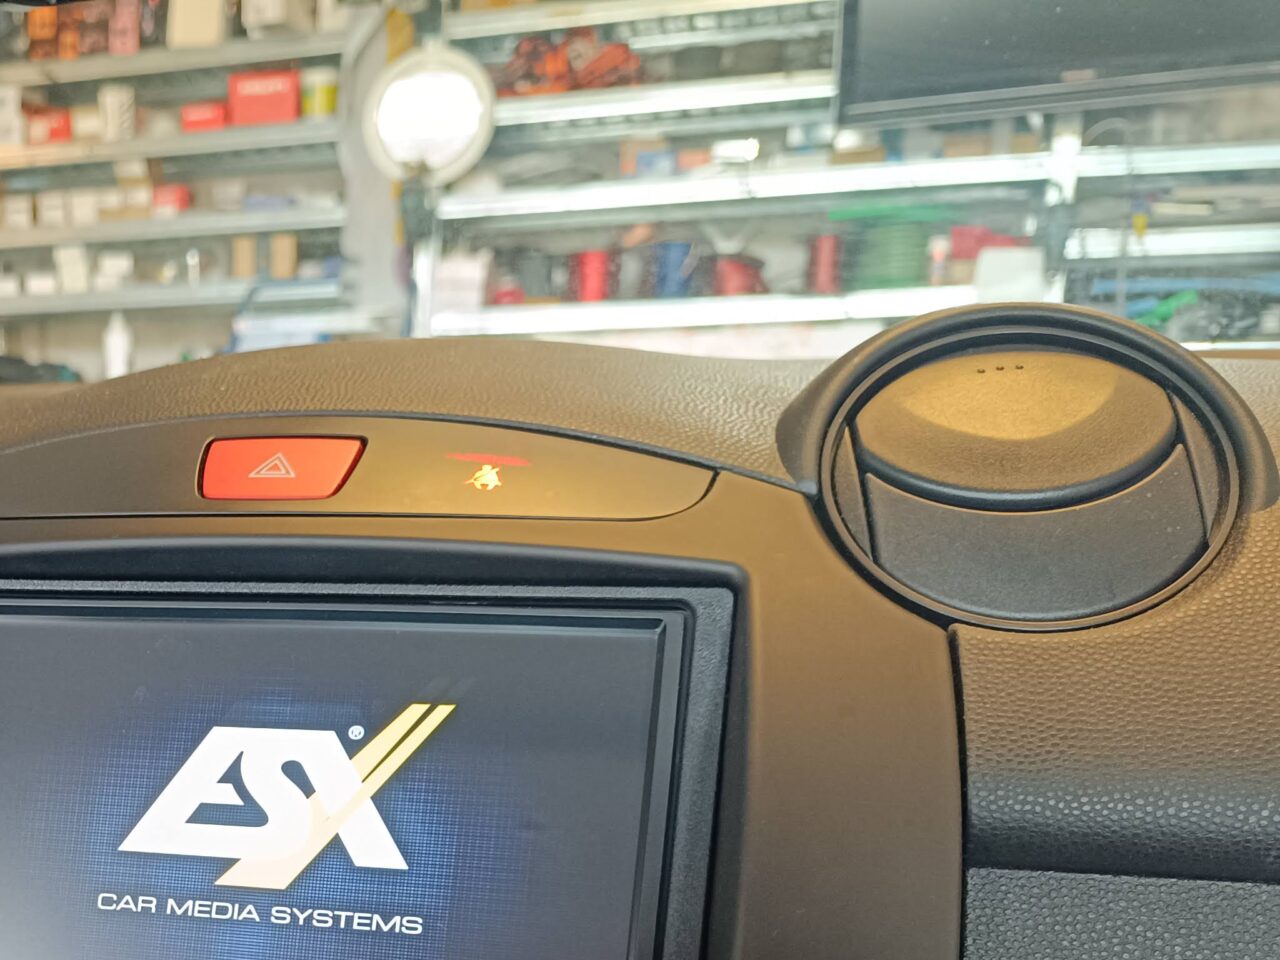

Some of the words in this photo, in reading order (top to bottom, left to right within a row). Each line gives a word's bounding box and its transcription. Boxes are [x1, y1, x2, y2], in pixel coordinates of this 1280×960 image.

[117, 703, 456, 890] ESX
[97, 892, 157, 914] CAR
[166, 898, 260, 922] MEDIA
[271, 906, 423, 935] SYSTEMS
